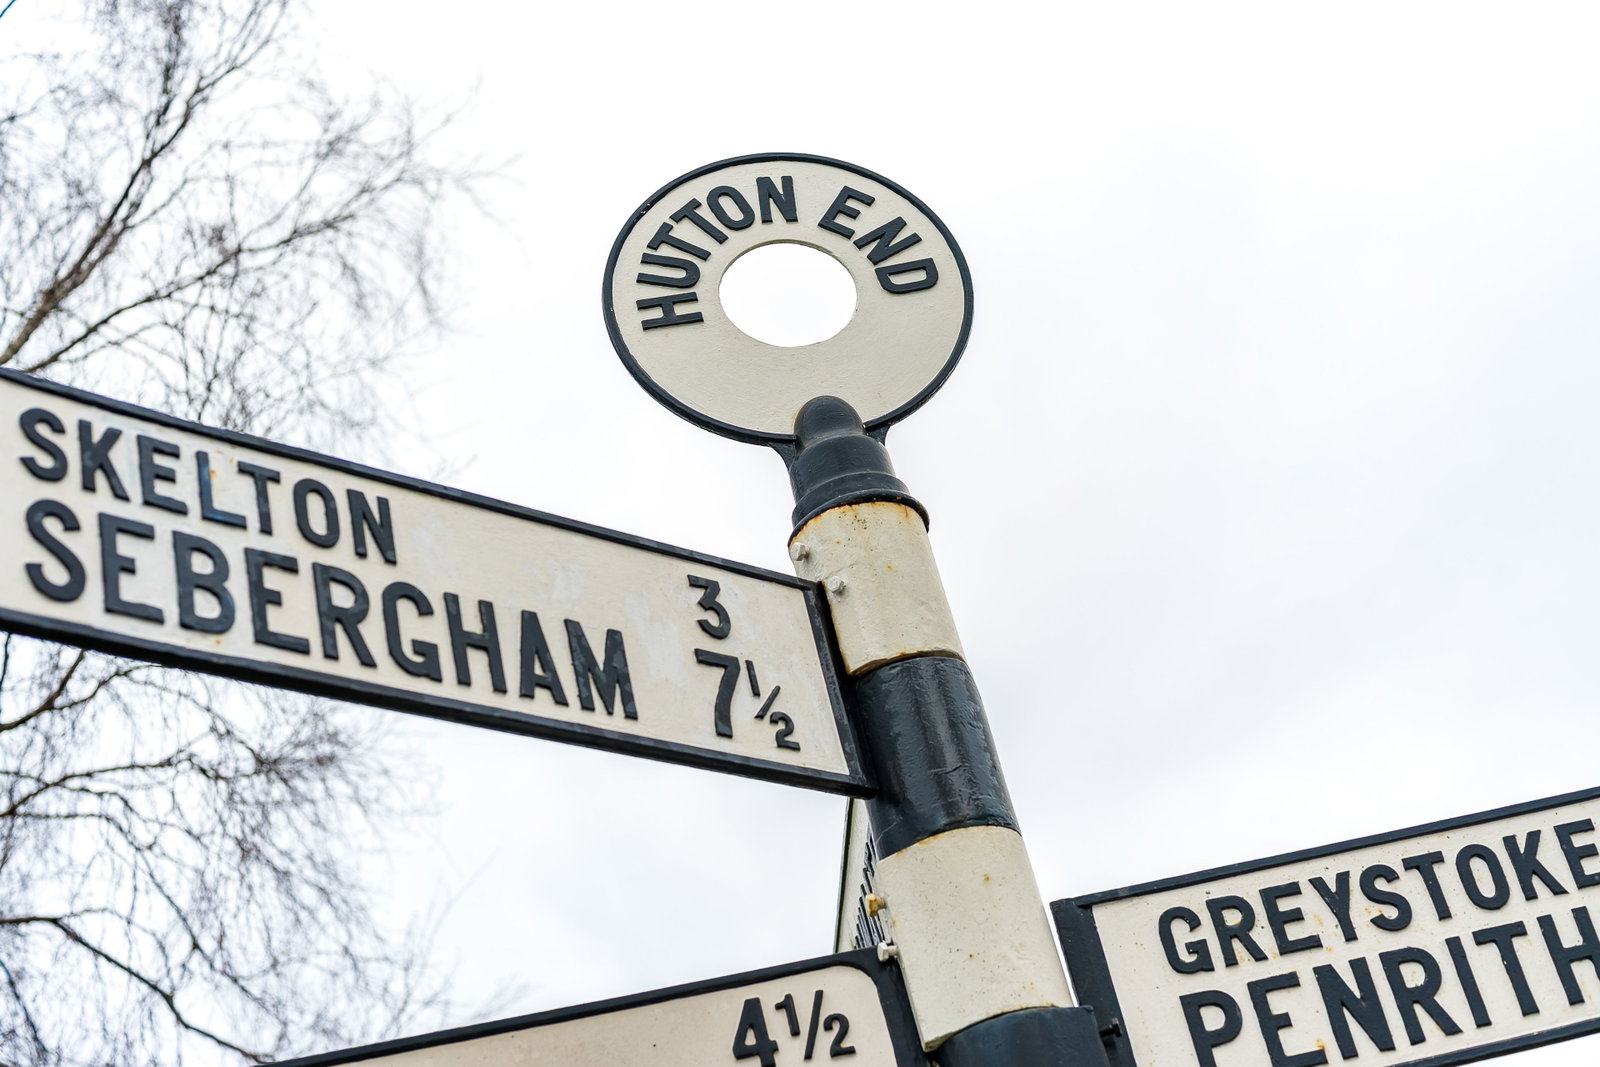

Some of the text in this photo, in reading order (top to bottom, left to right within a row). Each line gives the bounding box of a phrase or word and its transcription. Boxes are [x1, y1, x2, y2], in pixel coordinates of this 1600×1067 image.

[636, 175, 939, 331] HUTTON END
[19, 408, 732, 640] SKELTON 3
[25, 499, 637, 721] SEBERGHAM
[1158, 818, 1600, 974] GREYSTOKE
[1179, 906, 1600, 1067] PENRITH
